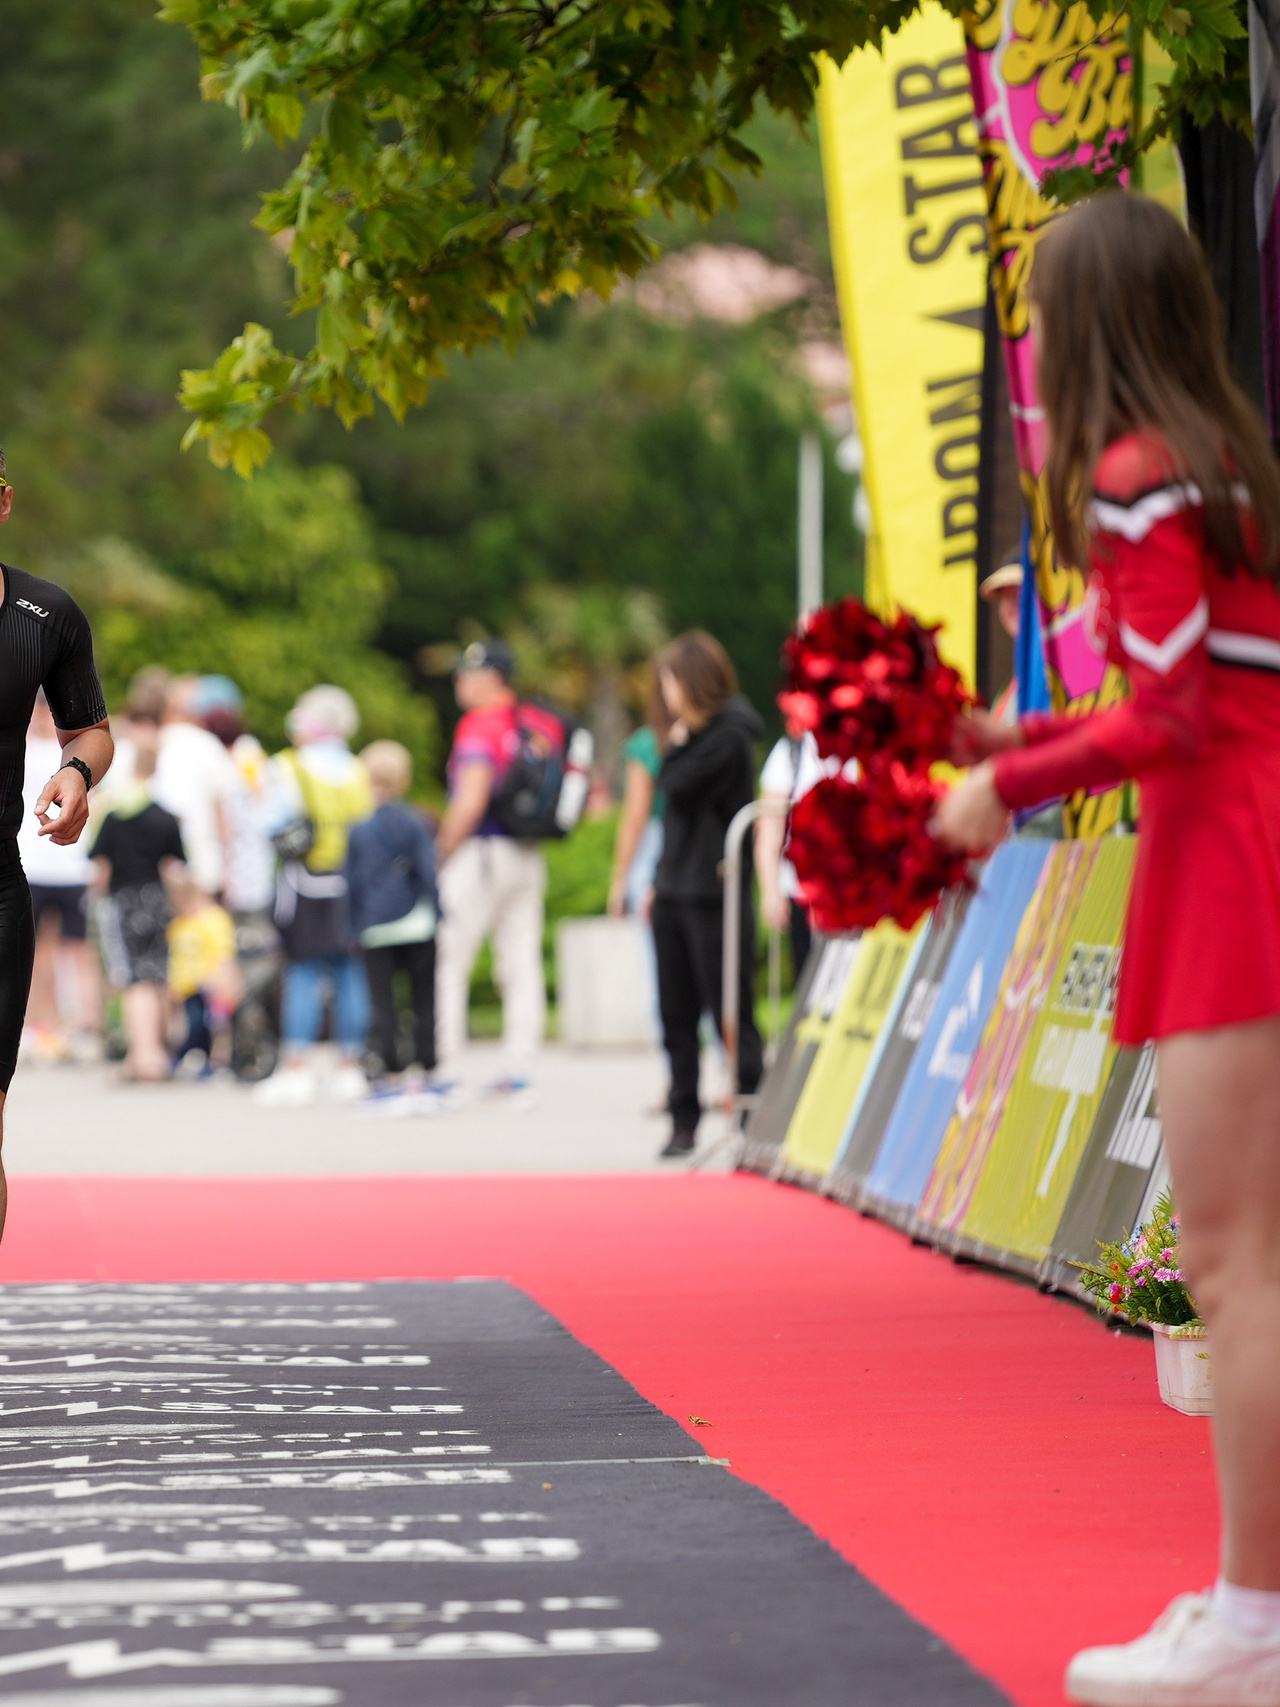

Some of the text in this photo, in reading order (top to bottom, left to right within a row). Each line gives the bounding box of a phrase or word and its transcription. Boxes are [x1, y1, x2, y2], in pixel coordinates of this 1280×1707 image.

[896, 54, 990, 264] STAR
[16, 598, 50, 618] 2XU
[160, 1401, 463, 1413] STAR
[158, 1445, 492, 1460] STAR
[160, 1469, 512, 1486] STAR
[184, 1537, 579, 1558] STAR
[207, 1627, 660, 1659] STAR
